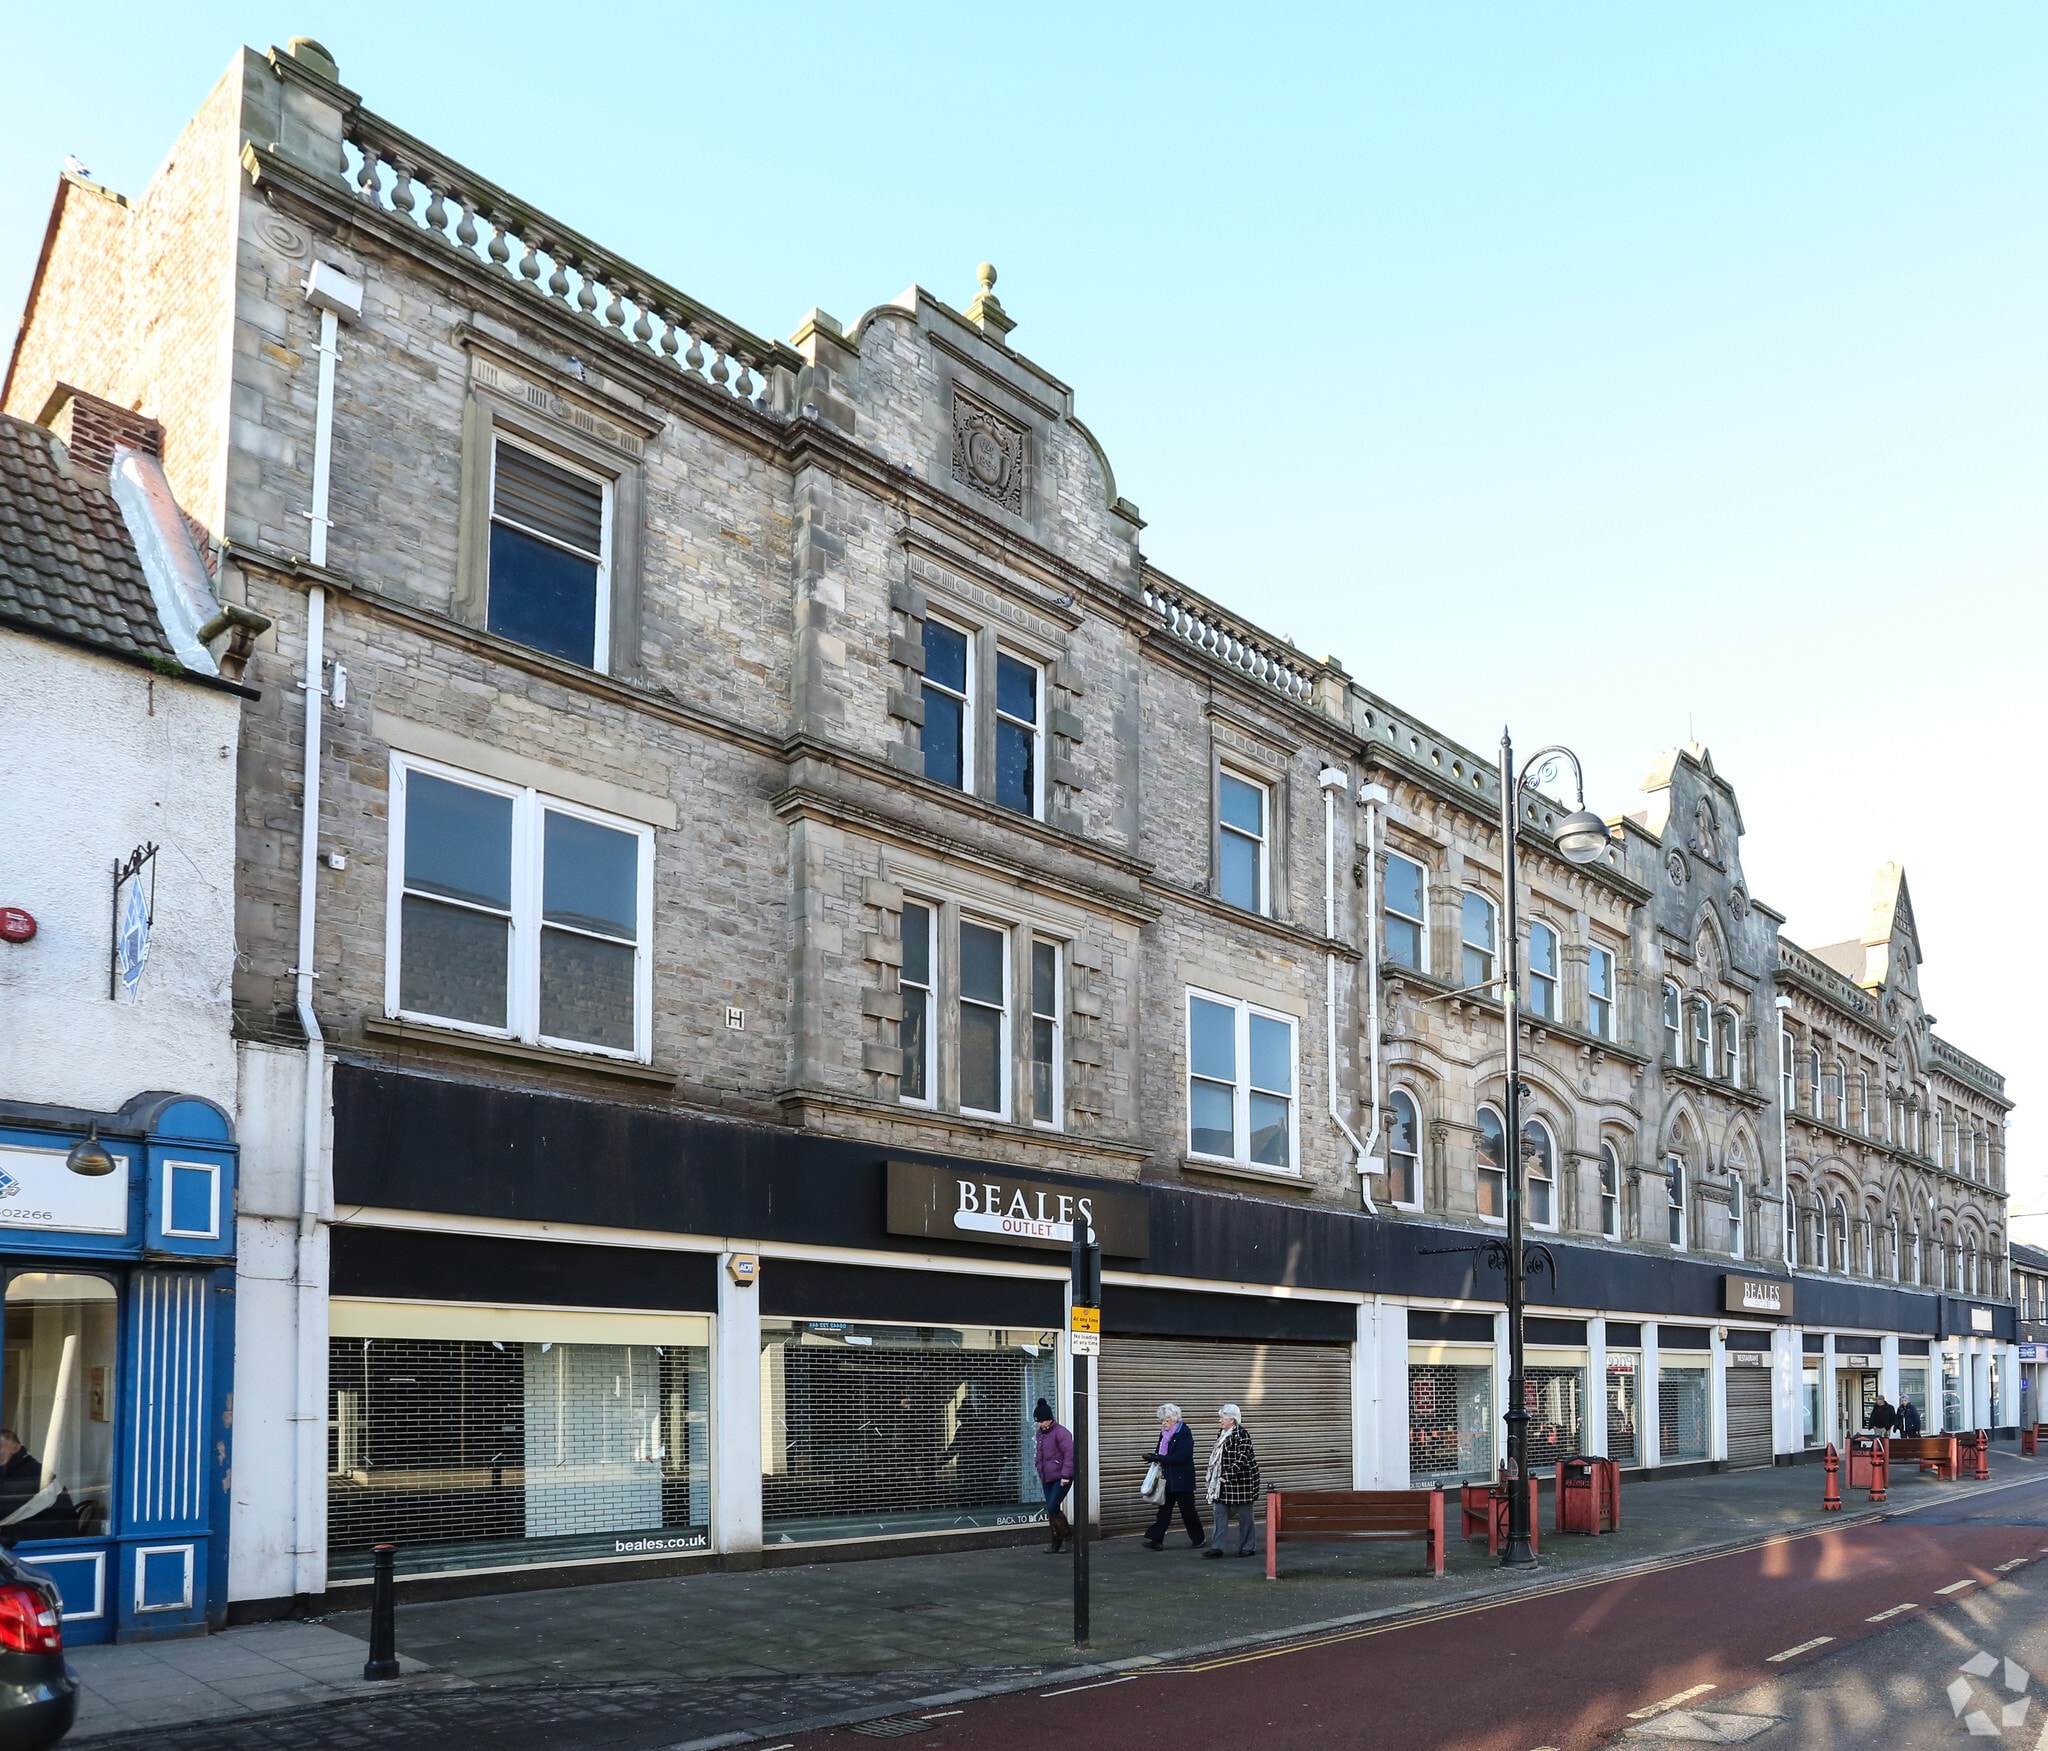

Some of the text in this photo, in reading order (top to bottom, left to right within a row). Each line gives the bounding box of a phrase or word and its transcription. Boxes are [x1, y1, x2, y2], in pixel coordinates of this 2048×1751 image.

[728, 1009, 742, 1028] H
[956, 1180, 1092, 1226] BEALES
[0, 1208, 52, 1220] 02266
[1002, 1219, 1052, 1236] OUTLET
[1744, 1282, 1779, 1301] BEALES
[997, 1513, 1049, 1526] BACK TO BEAL
[615, 1534, 707, 1552] beales.co.uk
